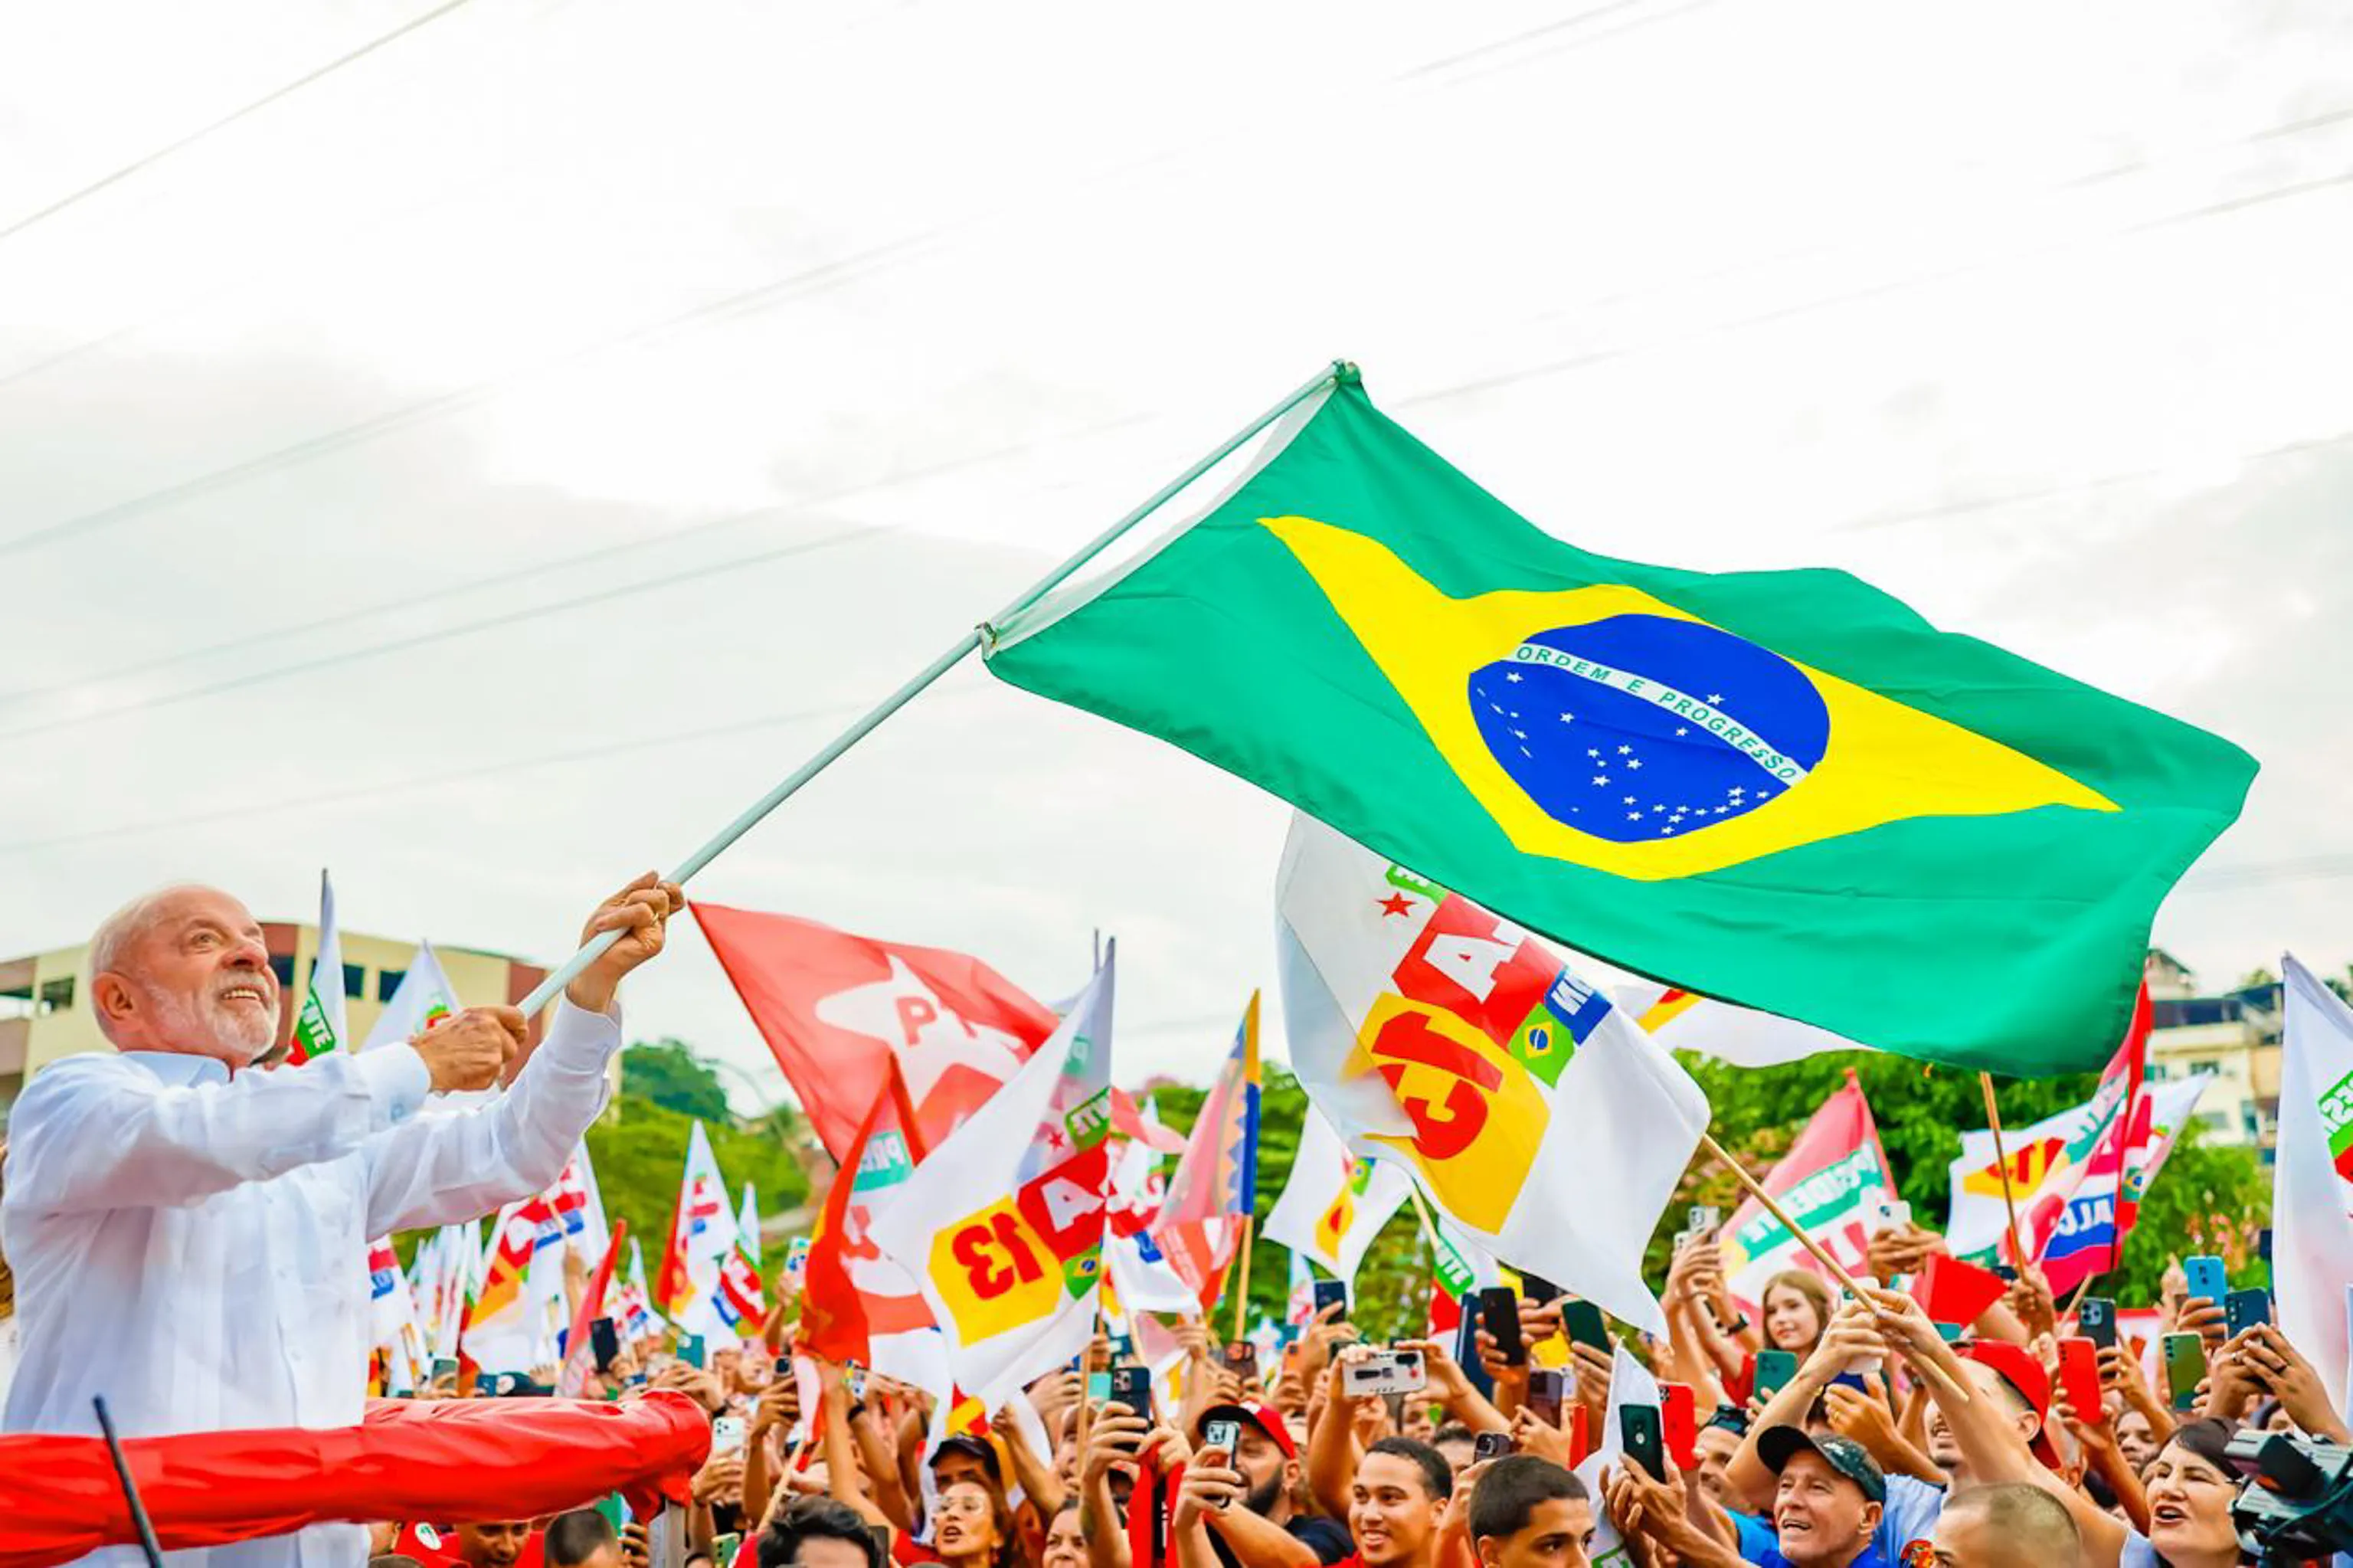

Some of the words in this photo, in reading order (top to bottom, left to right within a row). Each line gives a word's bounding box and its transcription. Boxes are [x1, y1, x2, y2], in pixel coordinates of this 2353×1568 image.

[1517, 647, 1610, 681] ORDEM
[1626, 679, 1645, 692] E
[1659, 692, 1797, 778] PROGRESSO
